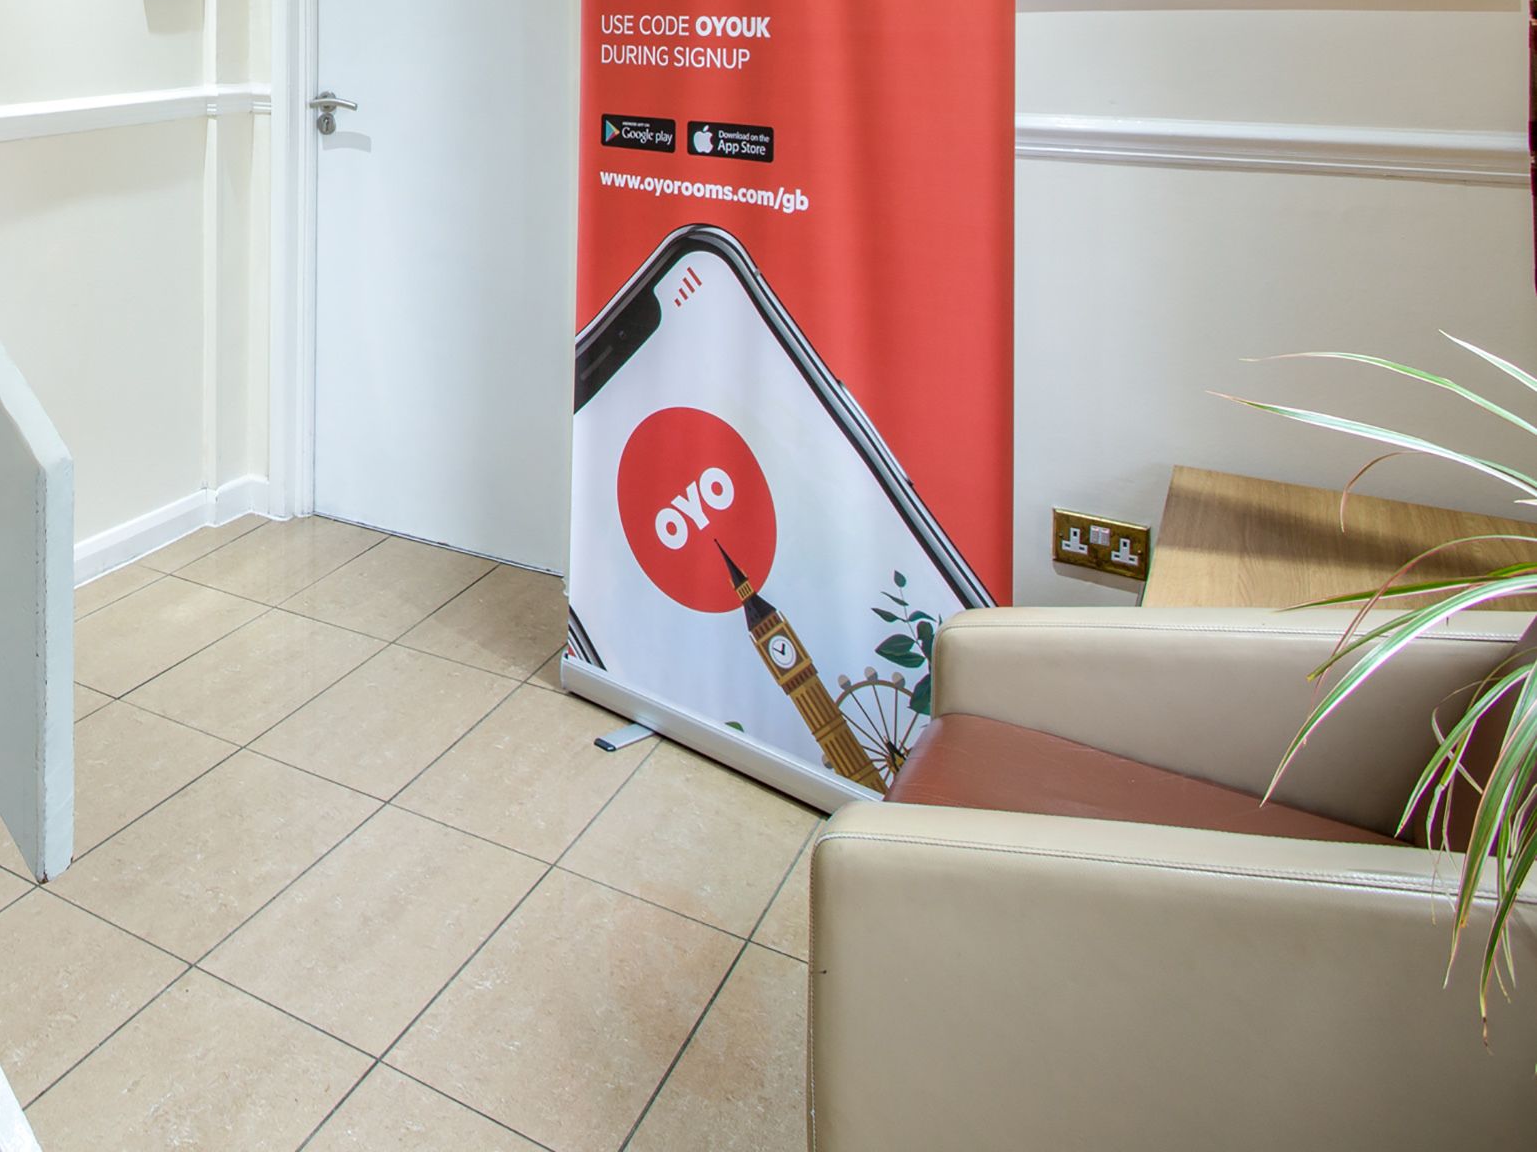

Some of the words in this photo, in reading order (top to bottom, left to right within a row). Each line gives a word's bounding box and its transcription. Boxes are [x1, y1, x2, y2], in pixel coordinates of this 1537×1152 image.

[601, 14, 634, 35] USE
[639, 15, 690, 36] CODE
[695, 16, 771, 38] OYOUK
[601, 44, 669, 66] DURING
[673, 47, 751, 70] SIGNUP
[622, 127, 654, 143] Google
[655, 131, 674, 145] play
[717, 140, 740, 155] App
[740, 141, 766, 155] Store
[718, 130, 749, 141] Download
[758, 133, 770, 143] the
[599, 171, 809, 214] www.oyorooms.com/gb
[654, 466, 735, 550] OYO
